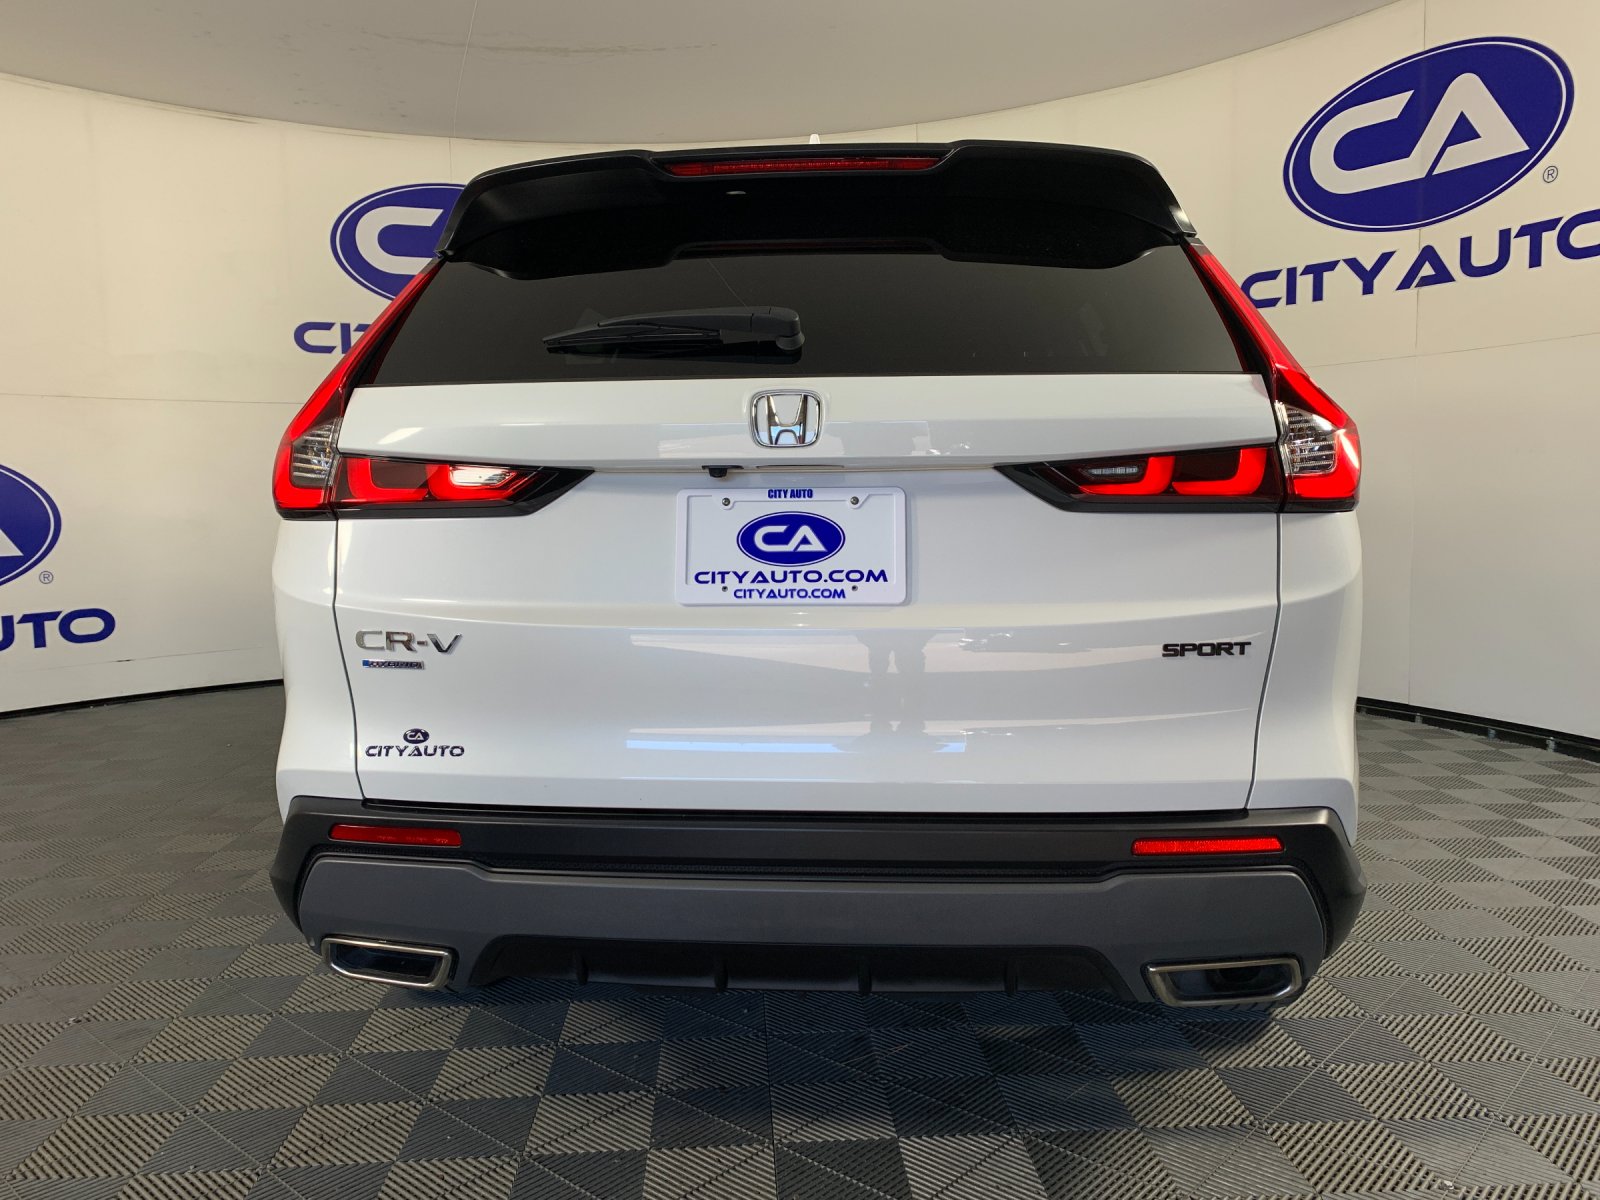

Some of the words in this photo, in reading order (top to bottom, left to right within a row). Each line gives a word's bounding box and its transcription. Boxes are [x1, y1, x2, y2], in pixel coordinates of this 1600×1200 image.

[767, 488, 789, 499] CITY
[790, 488, 814, 499] AUTO
[754, 524, 828, 552] CA
[694, 569, 888, 584] CITYAUTO.COM
[733, 588, 846, 600] CITYAUTO.COM
[355, 630, 463, 653] CR-V
[1161, 641, 1252, 658] SPORT
